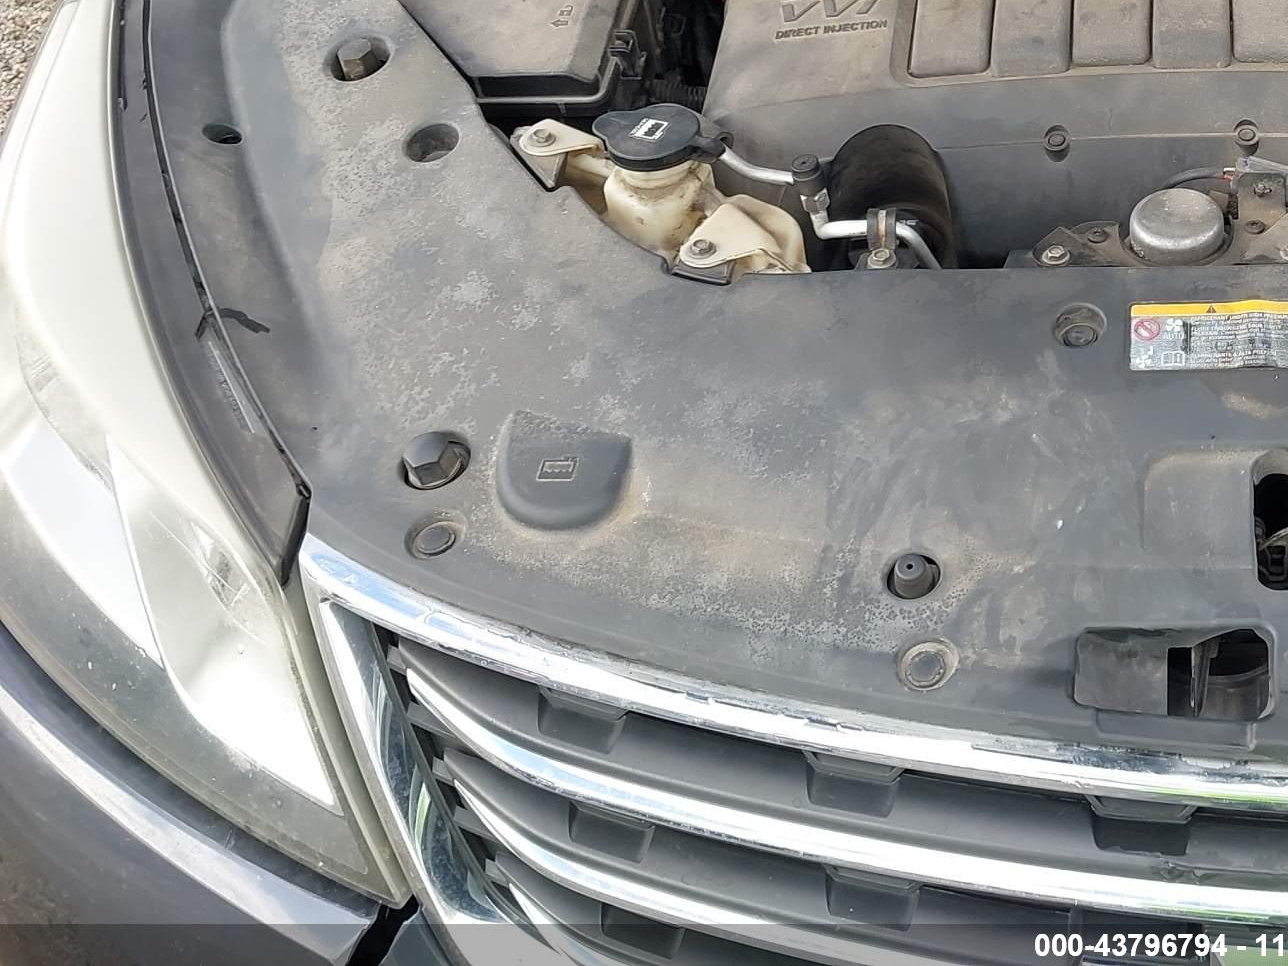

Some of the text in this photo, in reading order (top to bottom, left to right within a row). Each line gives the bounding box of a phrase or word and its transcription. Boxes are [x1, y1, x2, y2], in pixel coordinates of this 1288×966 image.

[775, 20, 888, 40] DIRECT INJECTION
[1163, 332, 1184, 340] AUTO
